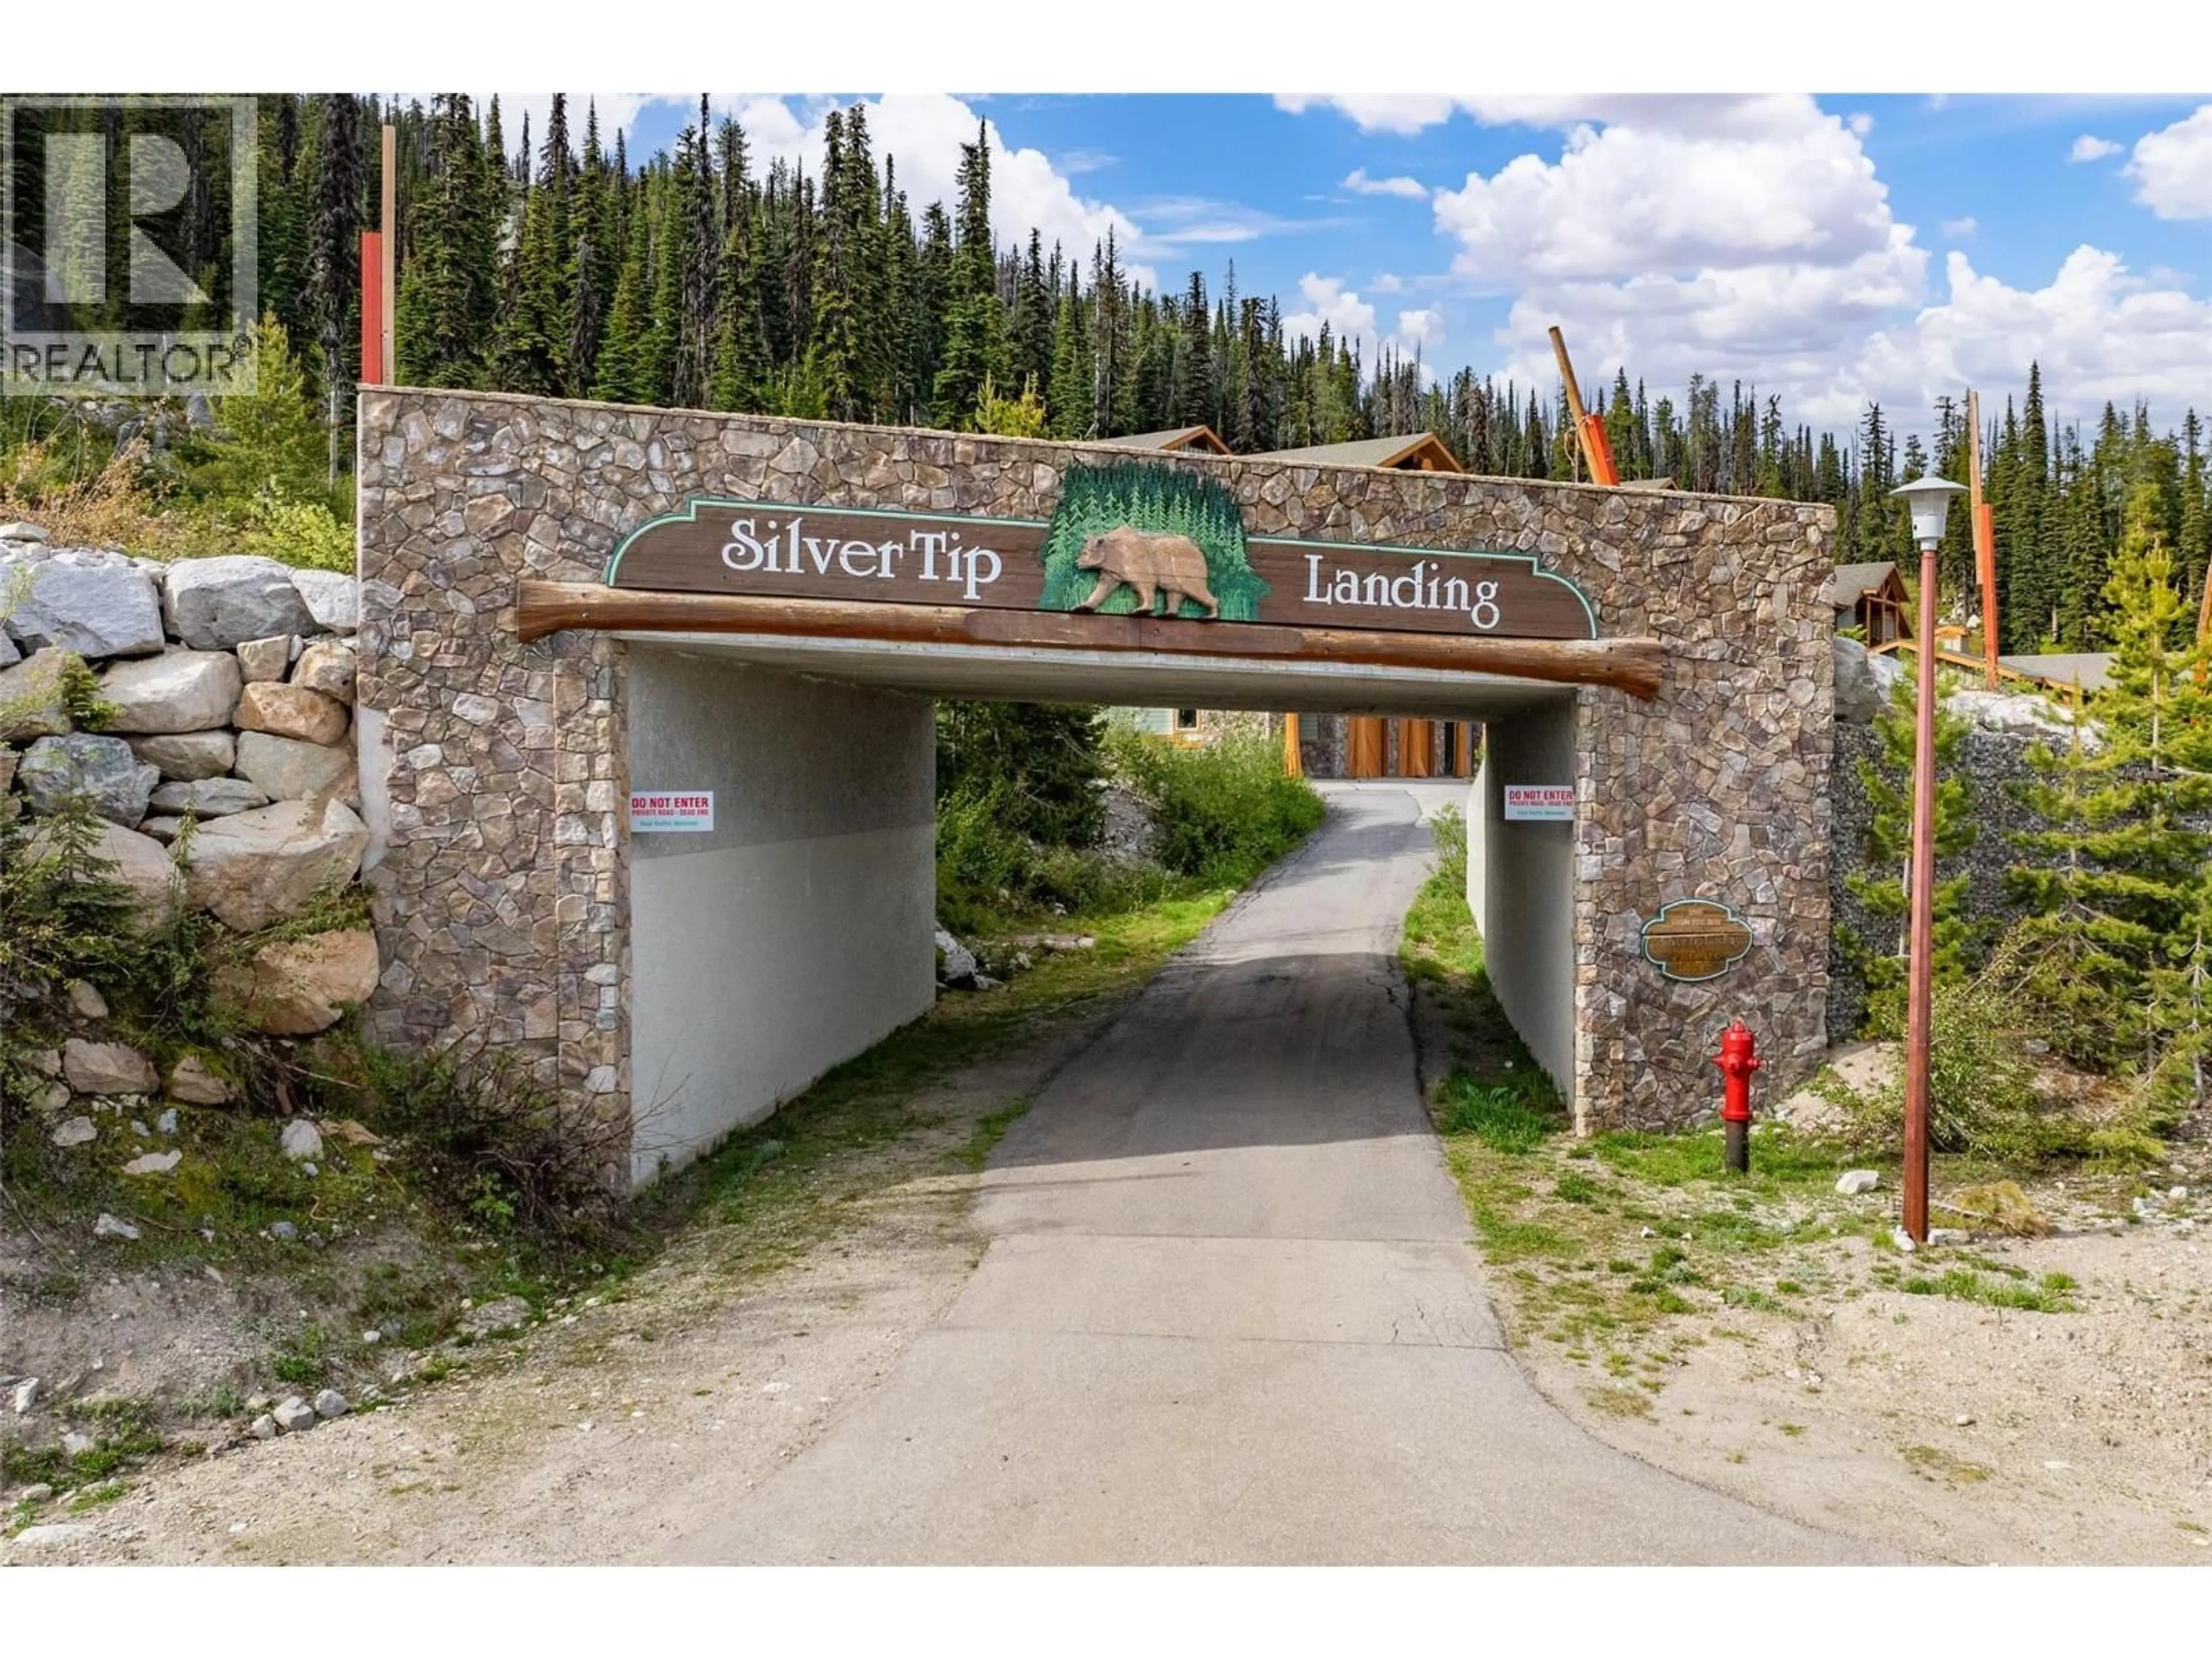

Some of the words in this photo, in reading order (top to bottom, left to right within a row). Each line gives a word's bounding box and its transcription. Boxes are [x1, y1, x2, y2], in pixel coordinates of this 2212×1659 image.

[1304, 554, 1499, 629] Landing
[1509, 790, 1521, 800] DO
[1524, 790, 1540, 800] NOT
[1544, 790, 1573, 800] ENTER
[632, 797, 646, 808] DO
[650, 797, 671, 808] NOT
[675, 797, 709, 808] ENTER
